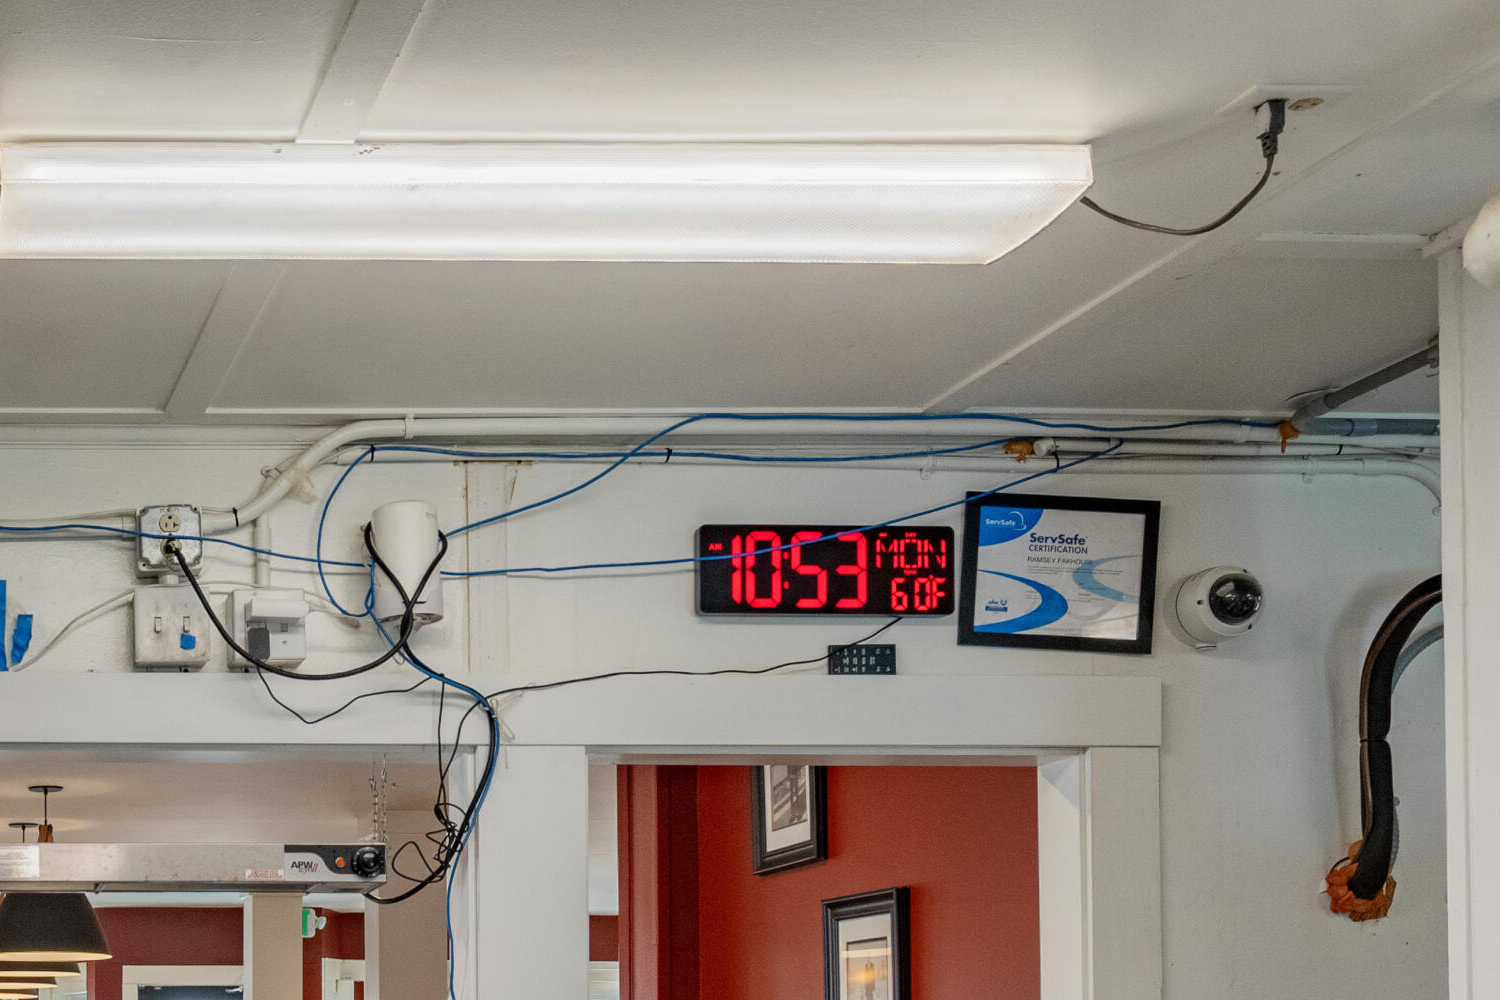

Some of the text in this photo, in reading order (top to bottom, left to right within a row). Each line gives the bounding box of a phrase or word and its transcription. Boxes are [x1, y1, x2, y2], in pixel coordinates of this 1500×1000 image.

[1029, 532, 1086, 546] ServSafe
[708, 543, 723, 551] AM
[1028, 544, 1089, 555] CERTIFICATION
[875, 539, 947, 569] MON
[1027, 555, 1057, 564] RAMSEY
[731, 531, 868, 609] 10:53
[290, 860, 313, 869] APW
